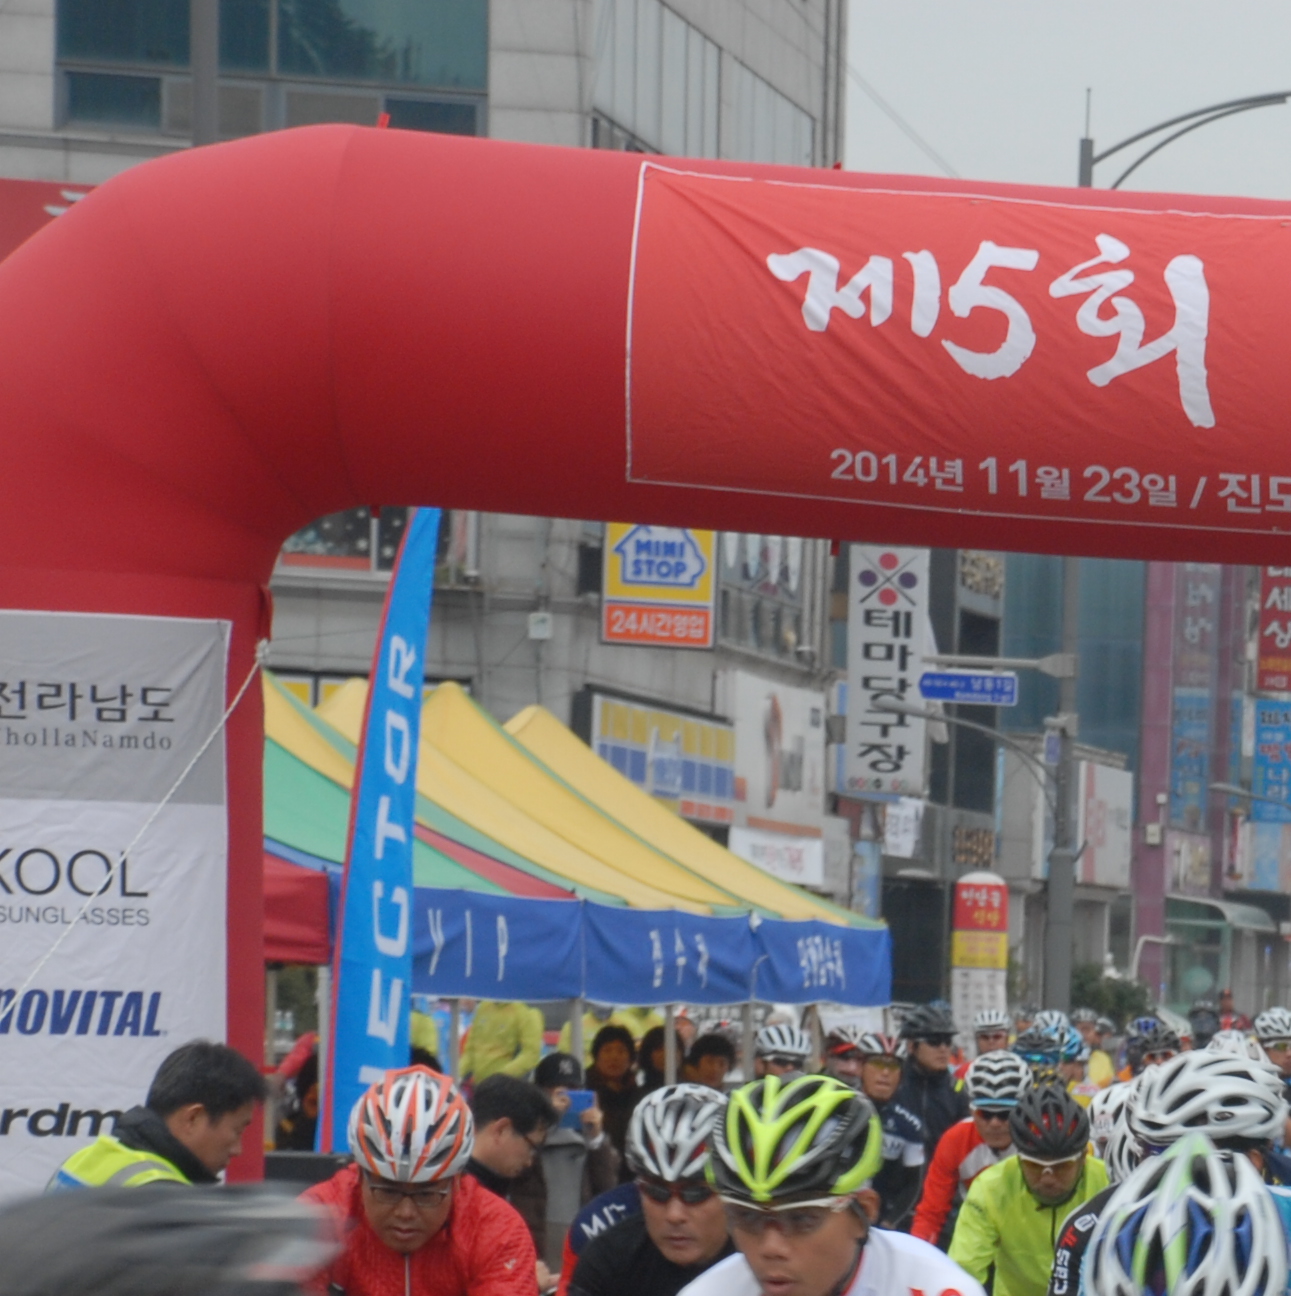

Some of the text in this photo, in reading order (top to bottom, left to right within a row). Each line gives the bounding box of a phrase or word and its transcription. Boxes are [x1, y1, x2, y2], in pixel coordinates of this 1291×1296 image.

[829, 447, 964, 493] 2014년
[978, 456, 1071, 501] 11월
[1082, 464, 1178, 508] 23일
[632, 559, 687, 579] STOP
[0, 727, 172, 750] hollaNamdo
